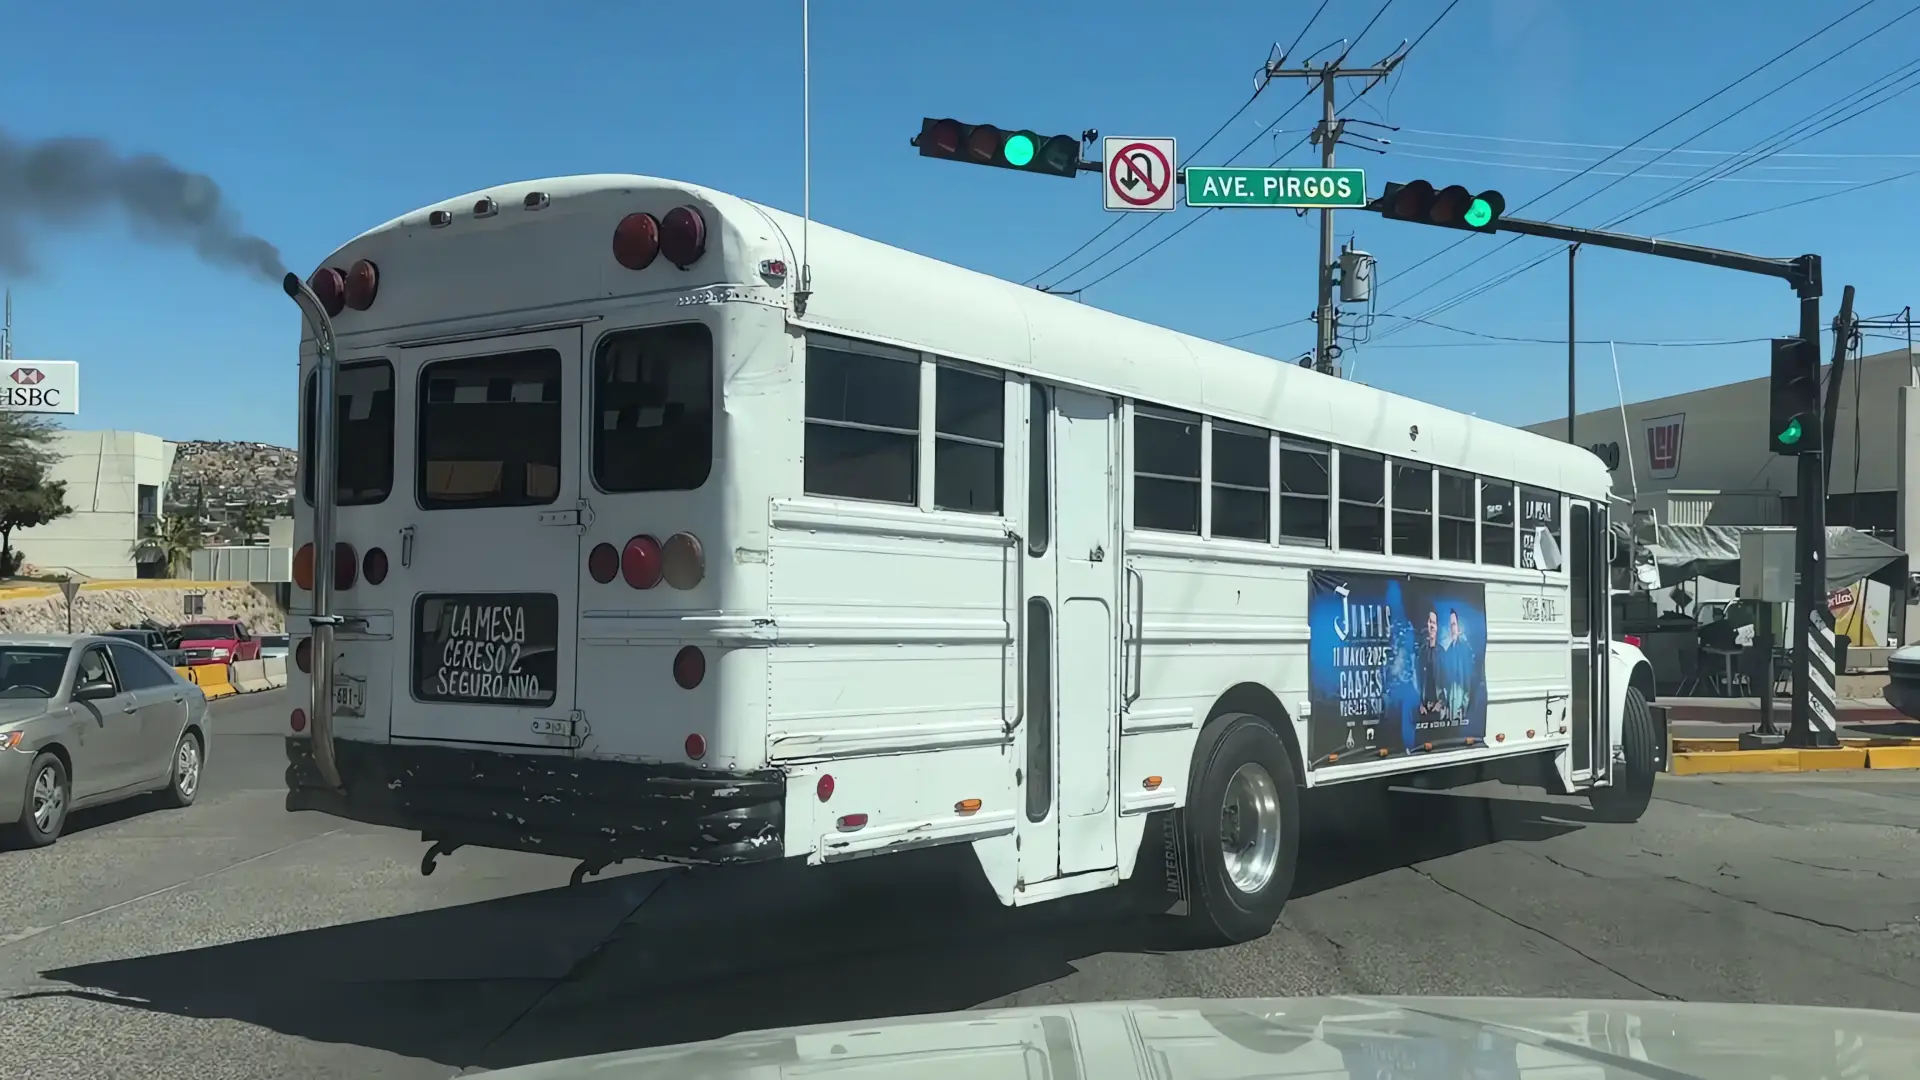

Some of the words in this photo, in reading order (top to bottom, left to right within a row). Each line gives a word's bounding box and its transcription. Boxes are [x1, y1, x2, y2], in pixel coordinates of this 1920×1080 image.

[1203, 176, 1254, 197] AVE.
[1263, 176, 1352, 198] PIRGOS
[451, 605, 470, 637] LA
[474, 606, 525, 644] MESA
[443, 638, 506, 674] CERESO
[508, 642, 522, 674] 2
[1342, 646, 1365, 667] MAYO
[1367, 646, 1388, 666] 2025
[437, 666, 503, 698] SEGURO
